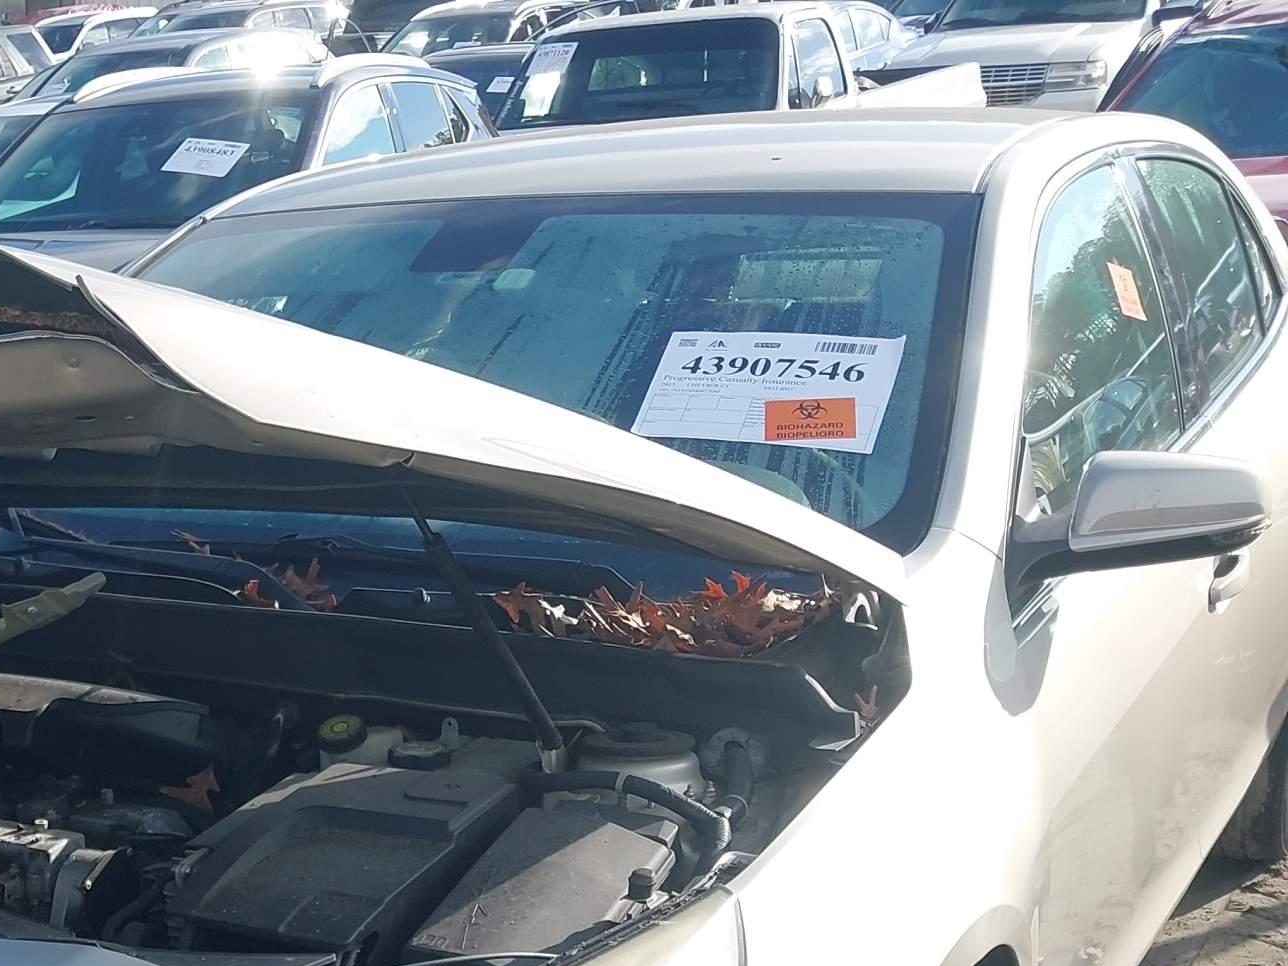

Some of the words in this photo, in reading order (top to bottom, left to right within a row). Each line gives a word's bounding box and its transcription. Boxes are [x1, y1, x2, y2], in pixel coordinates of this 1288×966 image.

[681, 355, 869, 384] 43907546
[663, 374, 717, 384] Progressive
[718, 375, 758, 385] Casualty
[761, 377, 807, 387] Insurance
[776, 421, 844, 431] BIOHAZARD
[776, 430, 845, 439] BIOPELIGRO
